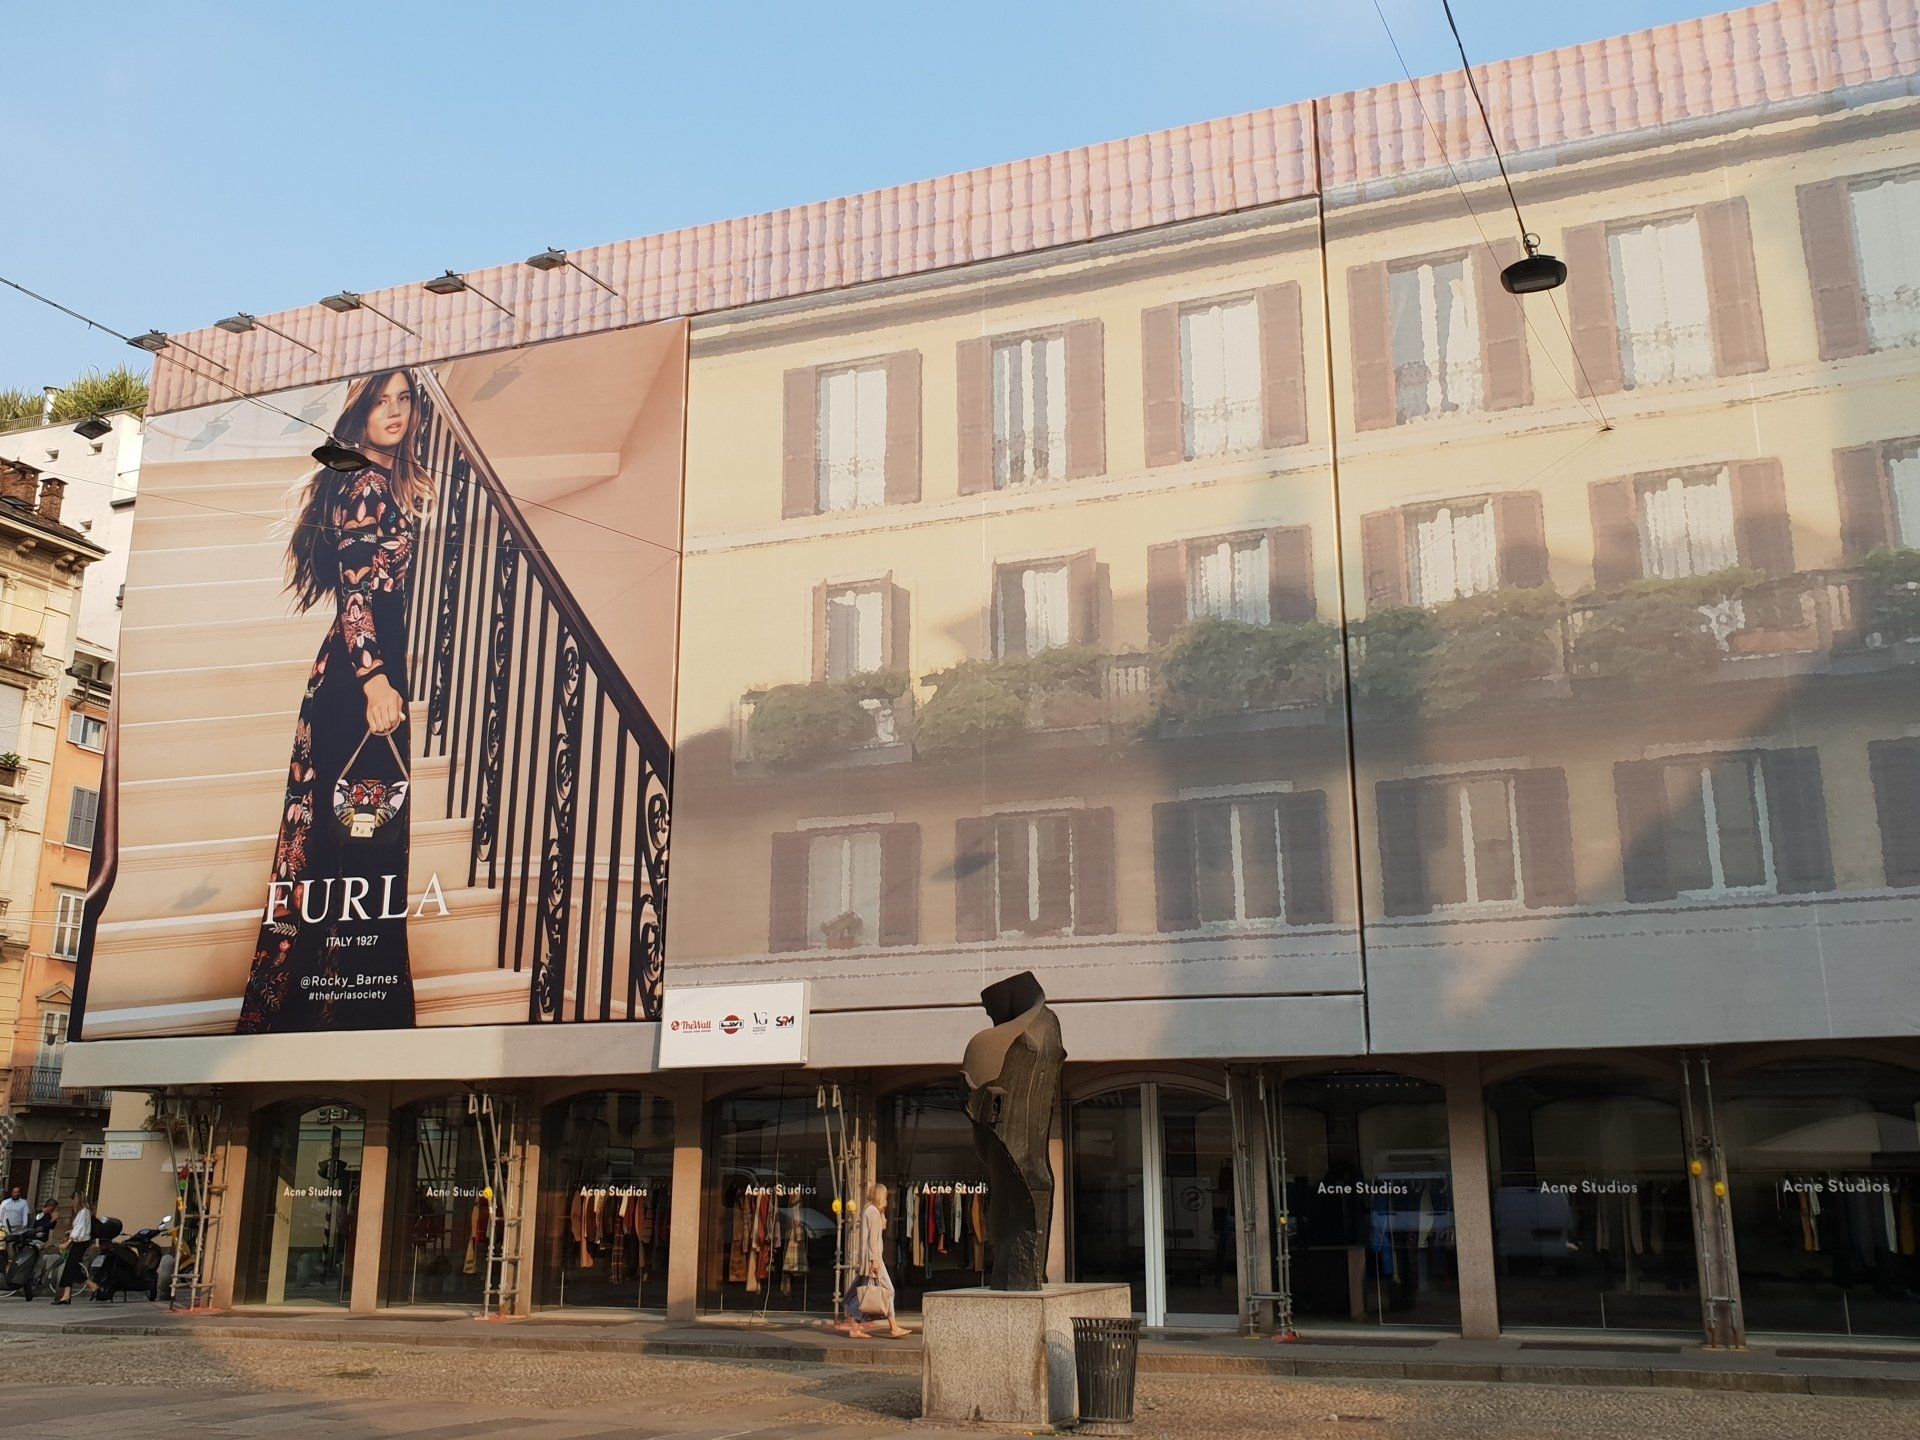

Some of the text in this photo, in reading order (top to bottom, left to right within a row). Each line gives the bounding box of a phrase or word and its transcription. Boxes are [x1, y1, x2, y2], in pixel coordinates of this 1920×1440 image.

[262, 872, 451, 926] FURLA
[326, 935, 379, 947] ITALY 1927
[300, 973, 398, 989] @Rocky_Barnes
[308, 990, 387, 1001] #thefurlasociety
[283, 1185, 343, 1197] Acne Studios
[426, 1185, 485, 1197] Acne Studio
[580, 1184, 648, 1197] Acne Studios
[744, 1183, 817, 1196] Acne Studios
[922, 1182, 952, 1195] Acne
[1317, 1181, 1408, 1195] Acne Studios
[1540, 1180, 1638, 1194] Acne Studios
[1783, 1179, 1891, 1193] Acne Studios
